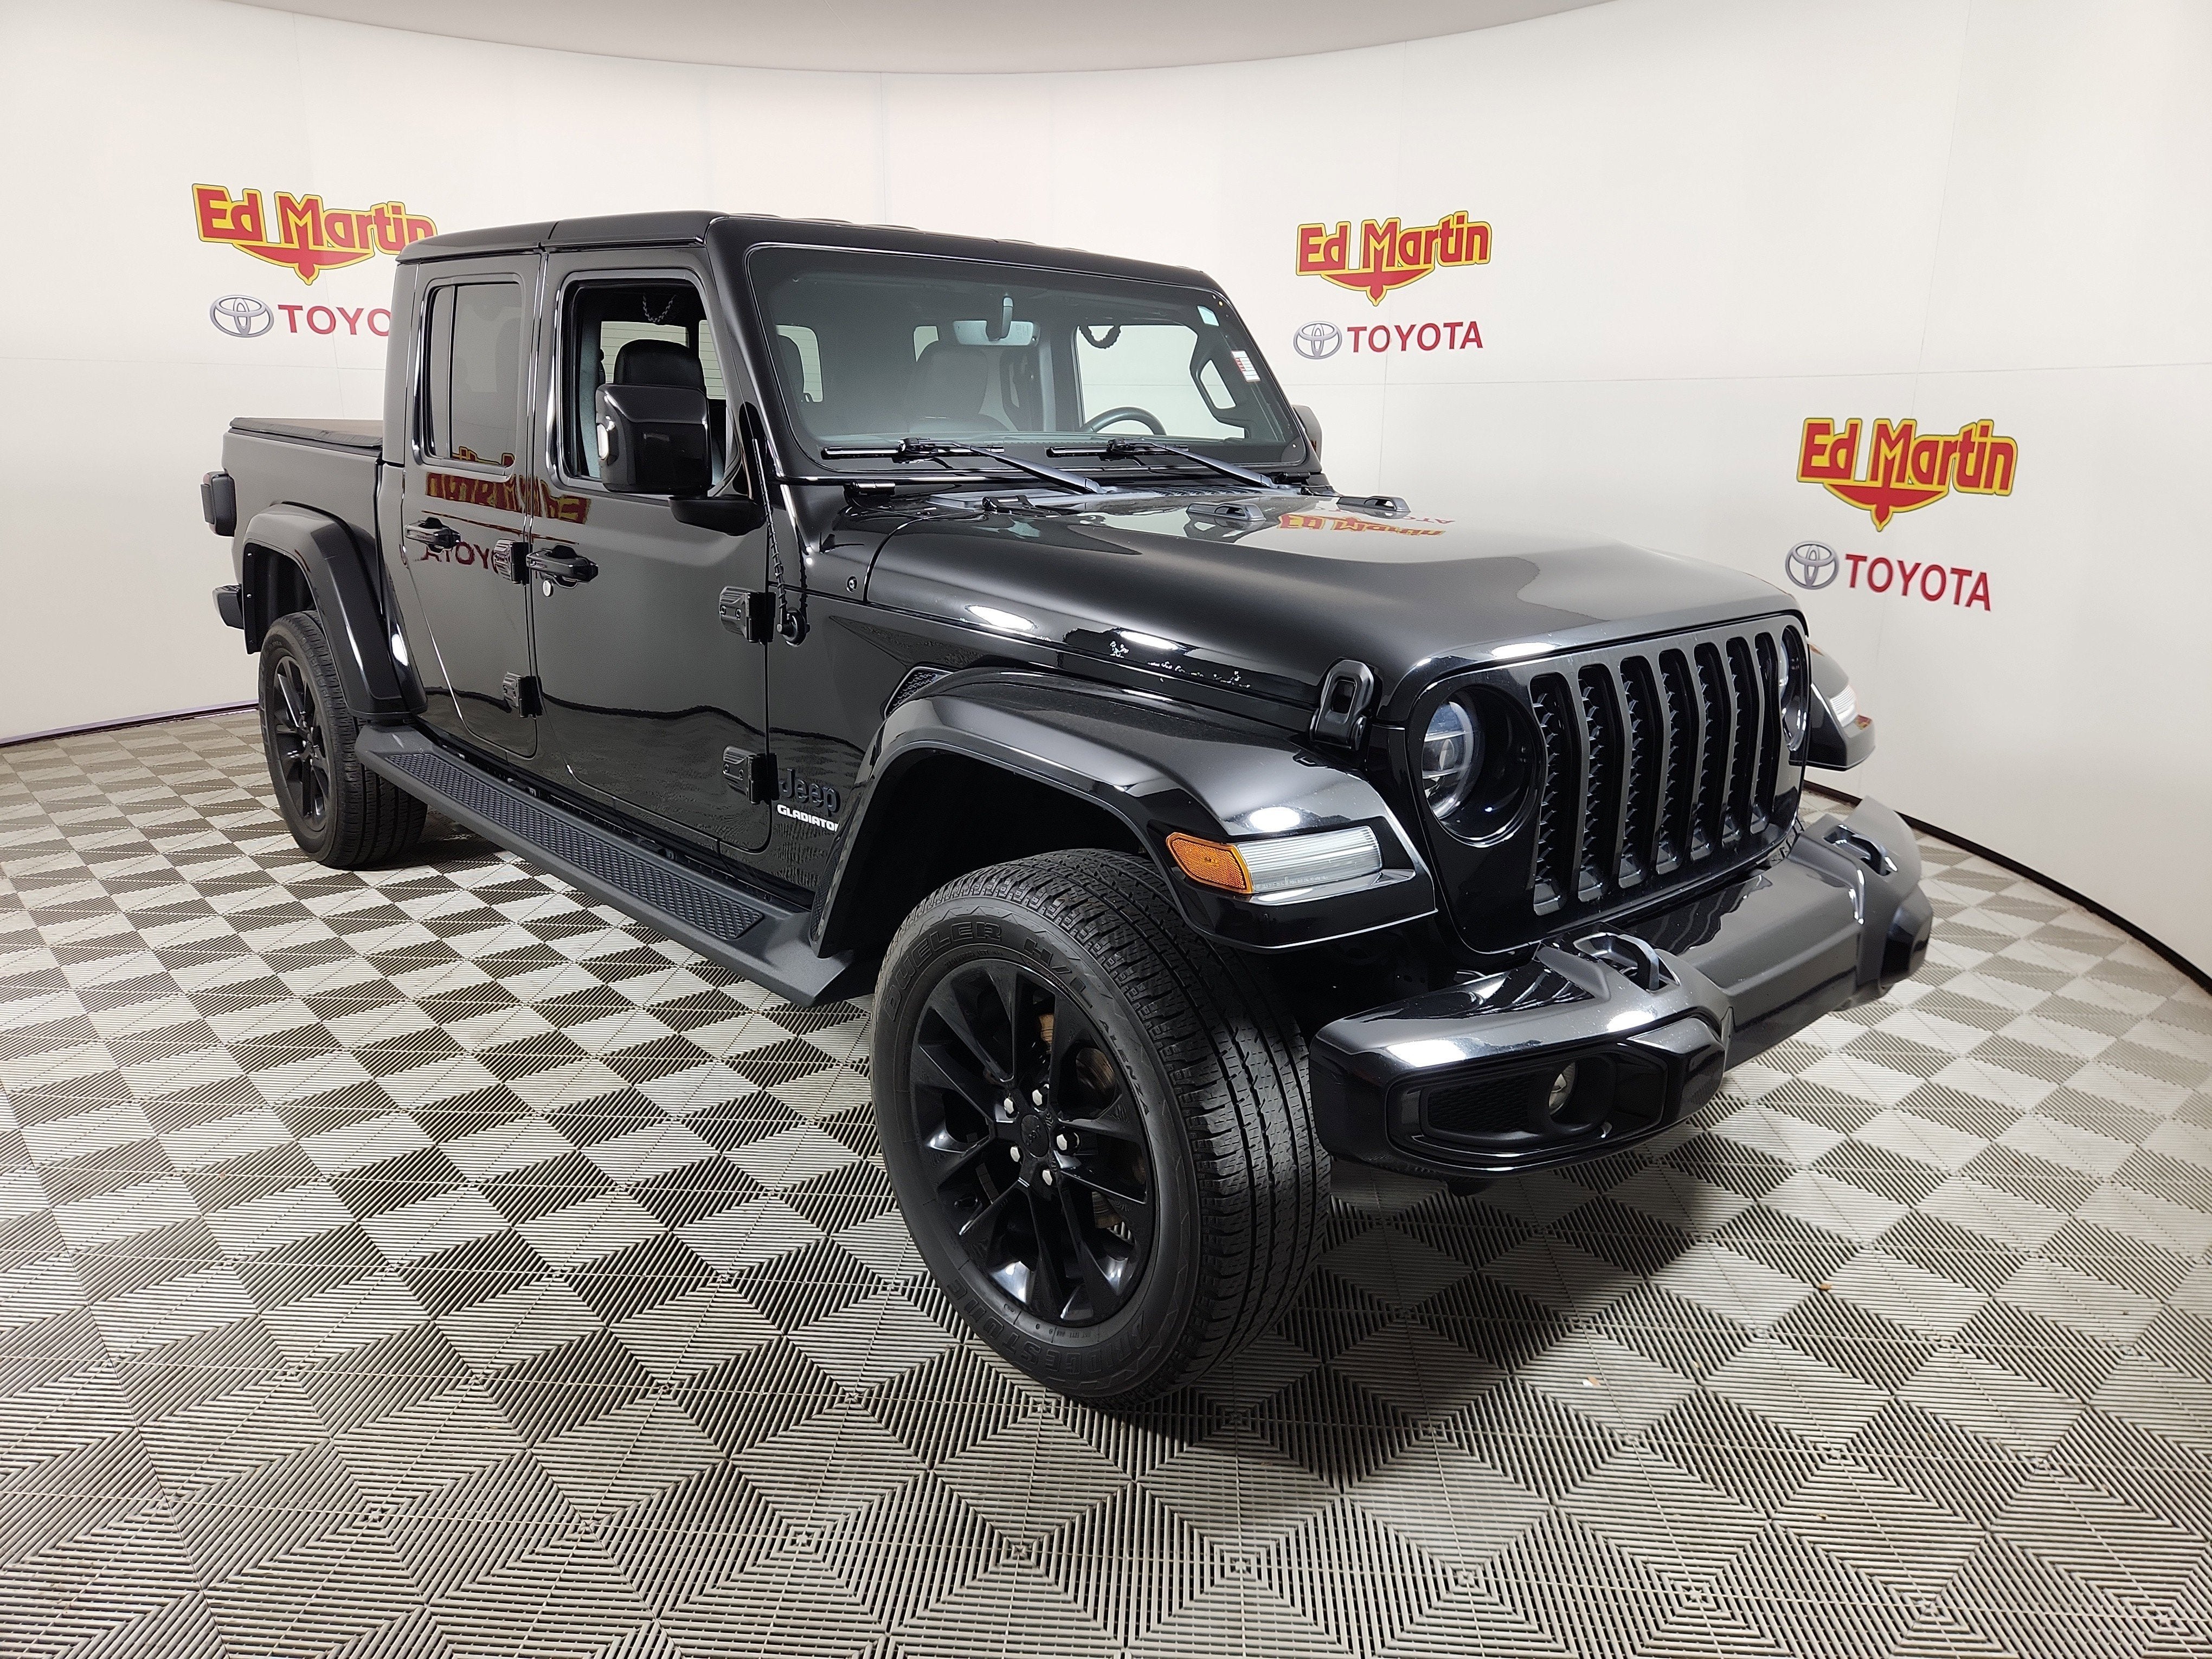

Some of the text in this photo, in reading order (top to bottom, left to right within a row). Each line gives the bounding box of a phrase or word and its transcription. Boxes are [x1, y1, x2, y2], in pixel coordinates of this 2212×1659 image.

[192, 183, 438, 255] Ed Martin
[1296, 210, 1492, 276] Ed Martin
[278, 304, 391, 337] TOYO
[1347, 321, 1483, 353] TOYOTA
[1797, 418, 2018, 497] Ed Martin
[1845, 553, 1992, 612] TOYOTA
[779, 768, 840, 818] Jeep
[884, 921, 1002, 1021] DUELER
[1099, 1019, 1150, 1116] ALENZA
